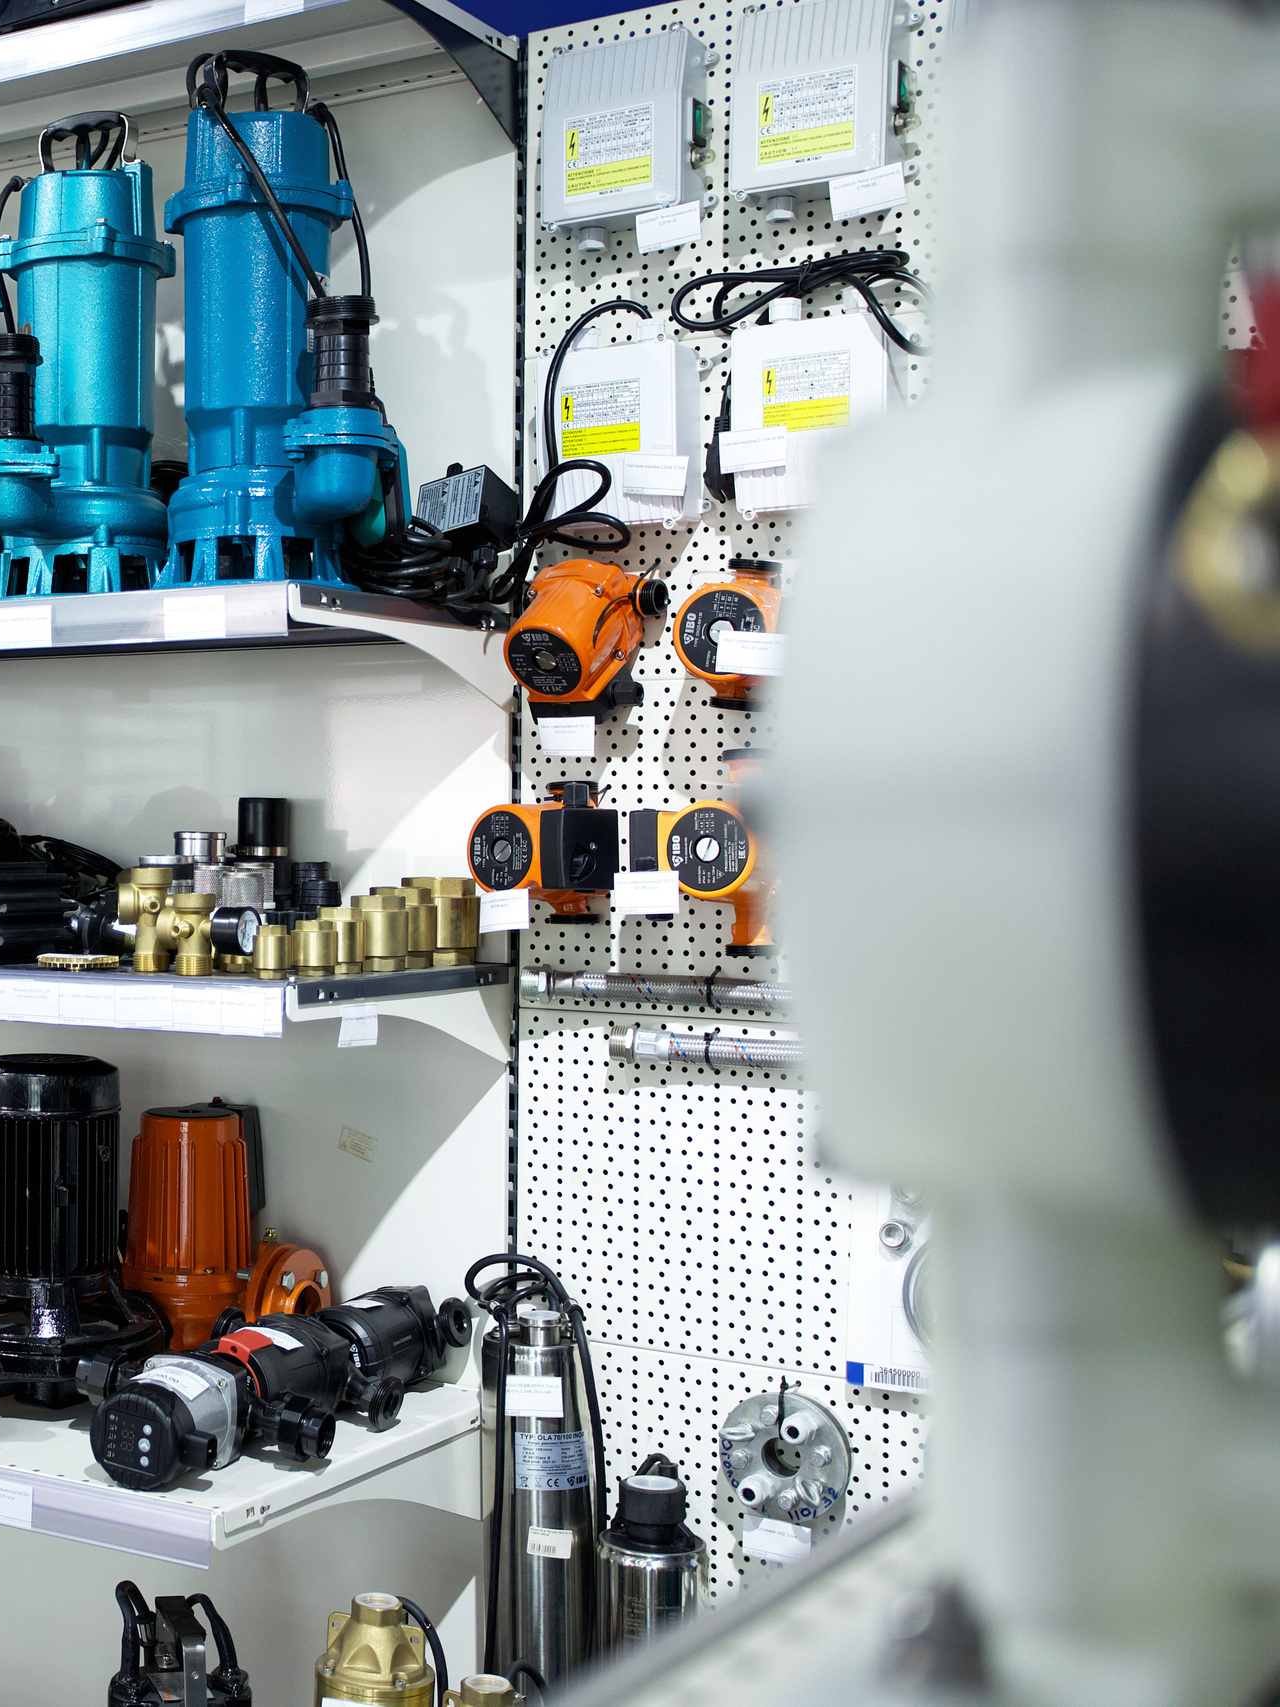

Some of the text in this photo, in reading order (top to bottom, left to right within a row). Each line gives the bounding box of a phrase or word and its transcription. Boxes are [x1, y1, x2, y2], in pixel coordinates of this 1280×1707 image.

[759, 148, 787, 157] CAUTION
[567, 181, 592, 189] CAUTION
[684, 612, 697, 634] IBO
[531, 634, 550, 642] IBO
[672, 834, 681, 855] IBO
[553, 1433, 572, 1441] 70/100
[575, 1474, 587, 1485] IBO
